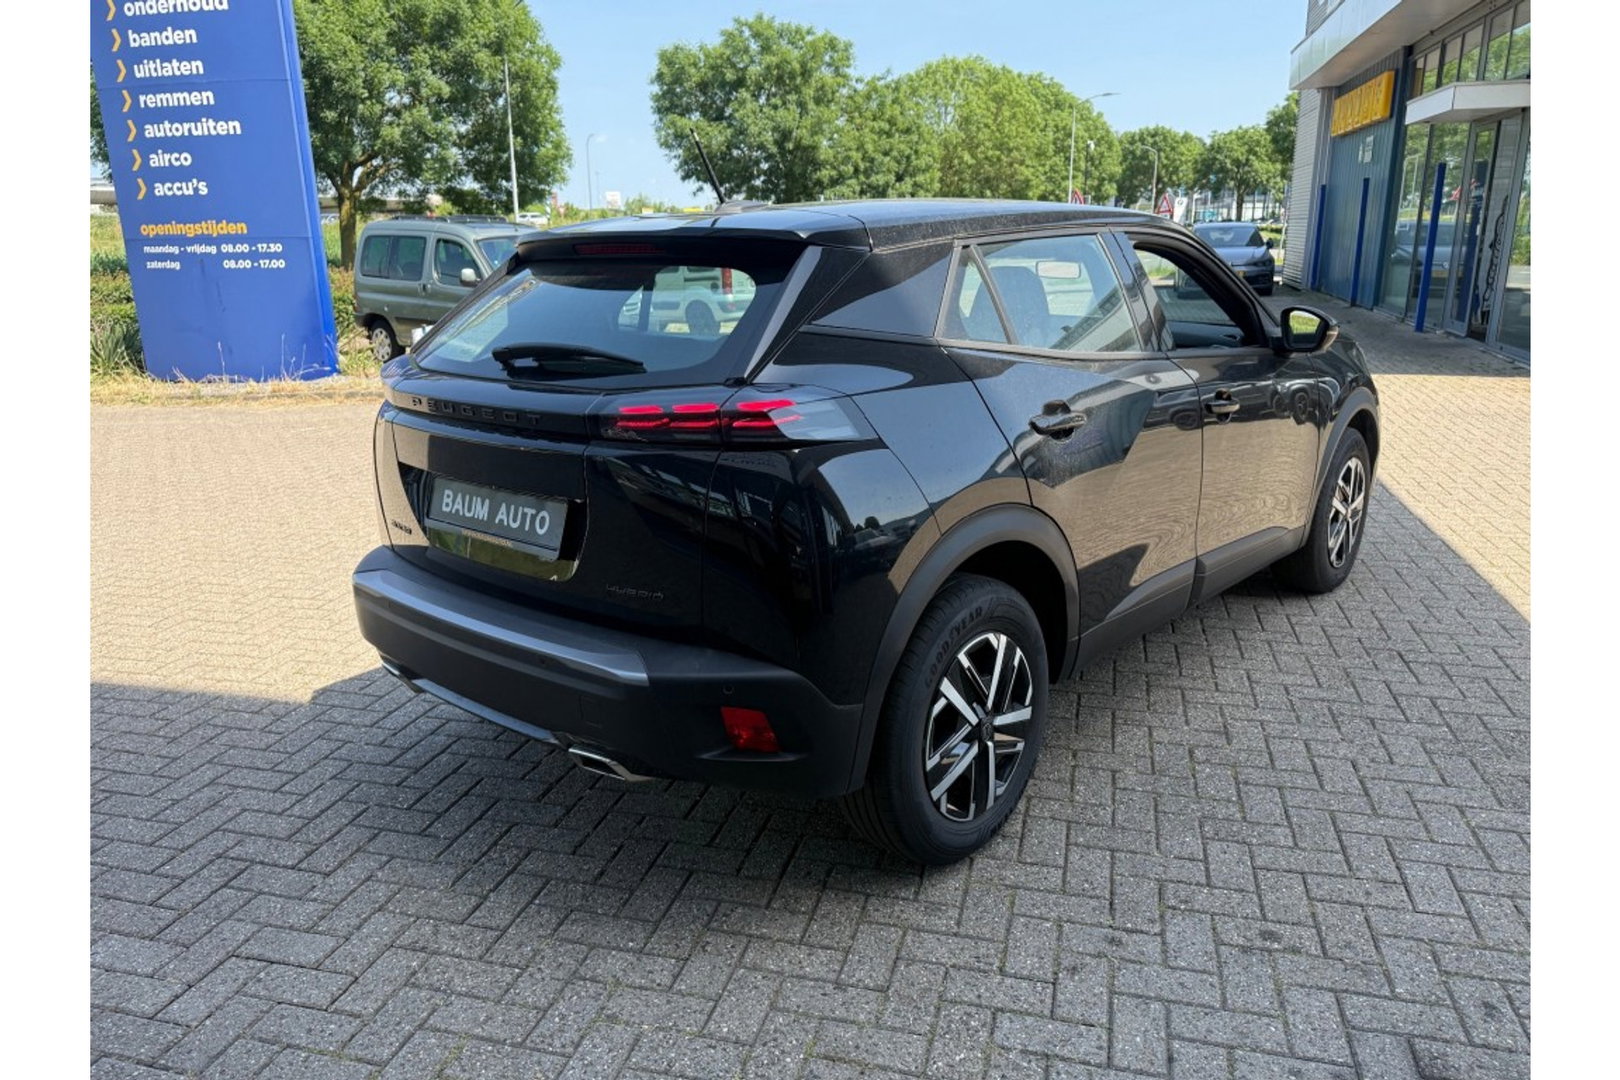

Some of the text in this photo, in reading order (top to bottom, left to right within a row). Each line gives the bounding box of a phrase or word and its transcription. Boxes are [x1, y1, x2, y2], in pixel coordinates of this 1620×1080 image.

[128, 26, 198, 48] banden
[133, 58, 204, 79] uitlaten
[138, 90, 215, 108] remmen
[144, 118, 242, 138] autoruiten
[149, 149, 192, 168] airco
[154, 179, 208, 196] accu's
[140, 219, 248, 238] openingstijden
[143, 245, 180, 254] maandag
[185, 244, 217, 255] vrijdag
[220, 243, 250, 253] 08.00
[257, 243, 283, 253] 17.30
[146, 260, 181, 270] zaterdag
[222, 259, 252, 269] 08.00
[259, 259, 286, 269] 17.00
[411, 396, 541, 425] PEUGEOT
[441, 489, 550, 536] BAUM AUTO
[924, 605, 983, 689] GOODYEAR
